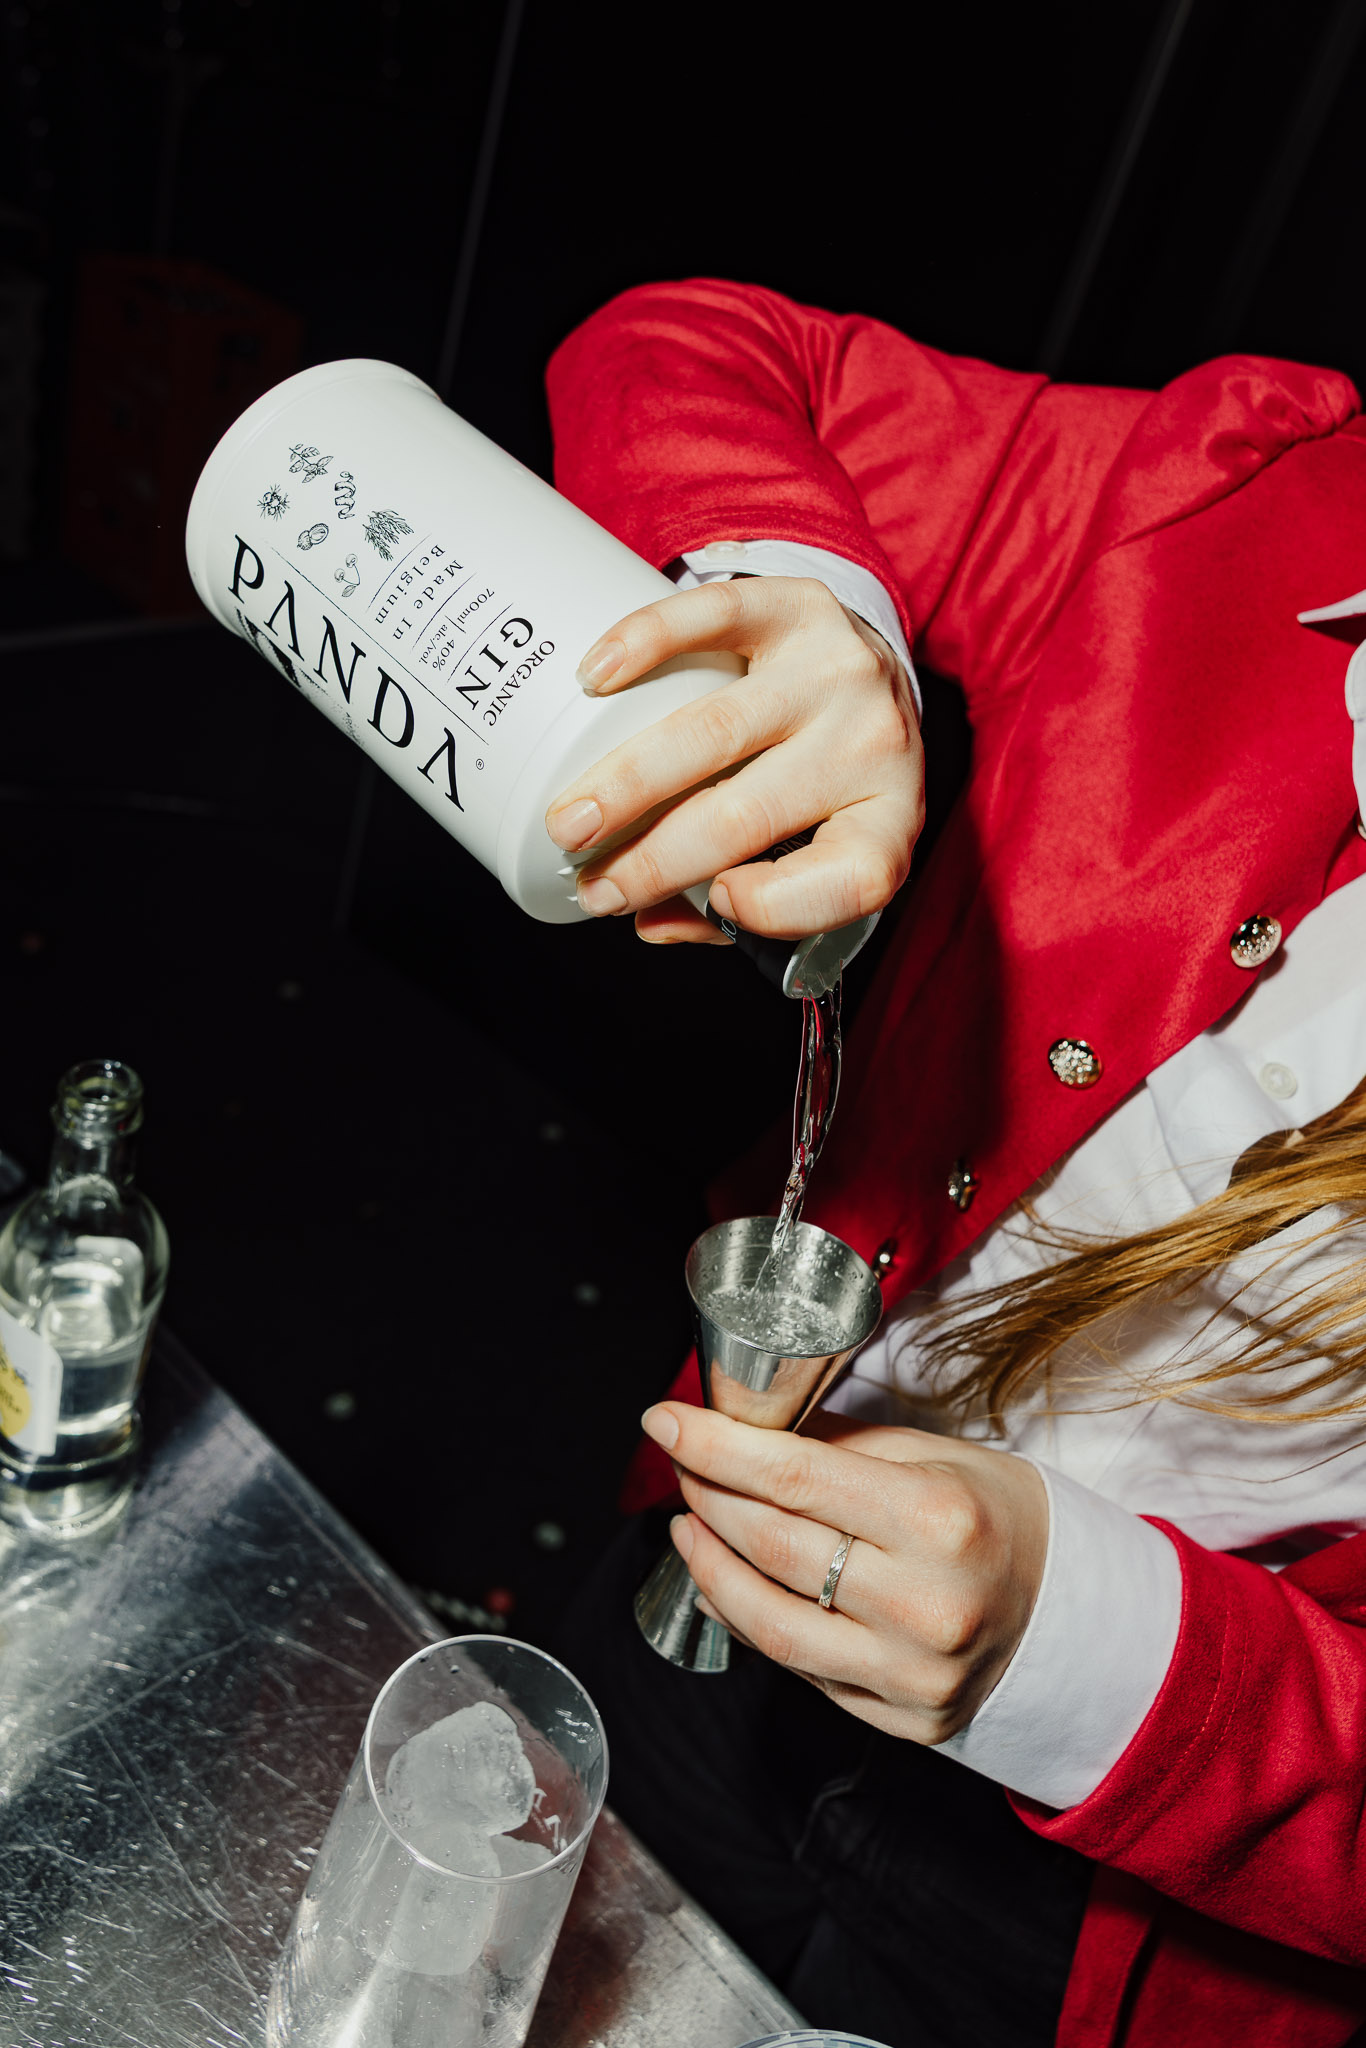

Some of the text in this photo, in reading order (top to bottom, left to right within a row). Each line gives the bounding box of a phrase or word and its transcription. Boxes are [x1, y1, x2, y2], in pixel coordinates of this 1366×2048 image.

[374, 544, 446, 624] Belgium
[392, 559, 464, 640] Made In
[456, 588, 495, 625] 700ml
[228, 534, 465, 813] PANDA
[432, 639, 455, 671] 40%
[455, 617, 534, 711] GIN
[482, 640, 555, 727] ORGANIC
